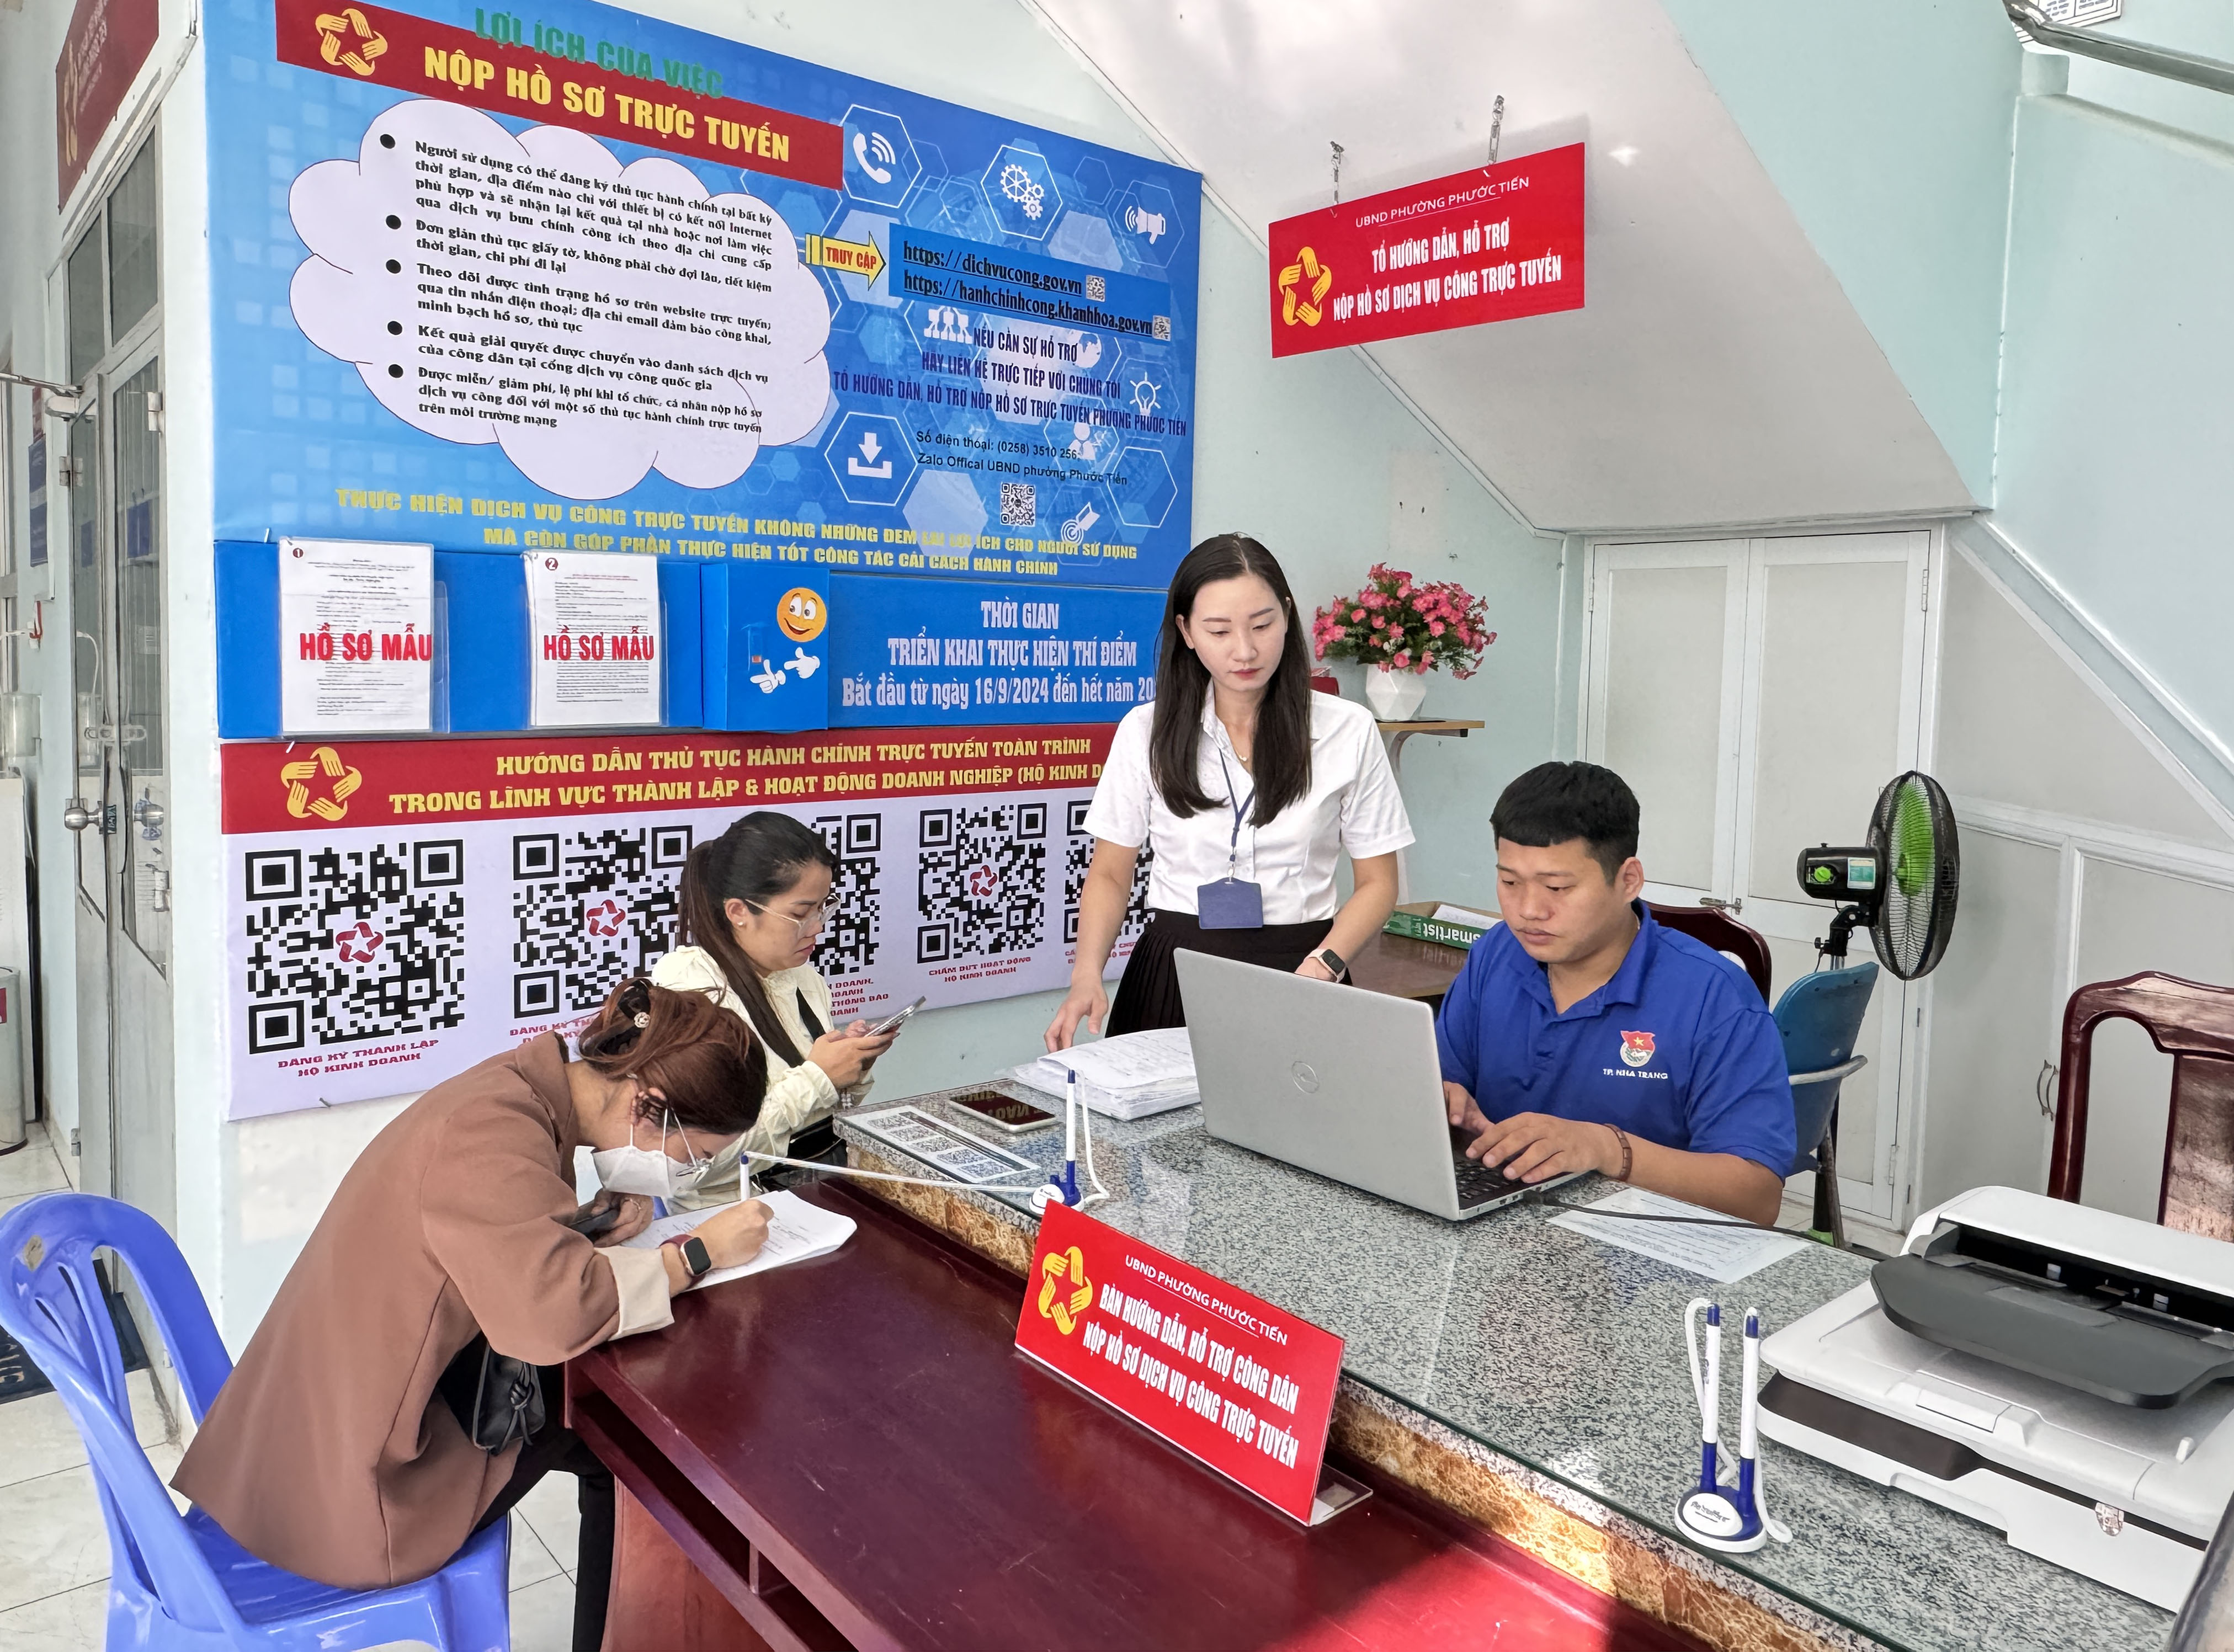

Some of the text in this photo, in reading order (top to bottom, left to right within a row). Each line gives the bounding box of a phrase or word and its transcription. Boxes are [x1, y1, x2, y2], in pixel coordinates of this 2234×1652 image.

[425, 46, 789, 162] NỘP HỒ SƠ TRỰC TUYẾN
[549, 188, 772, 239] nào Internet
[1356, 175, 1529, 227] UBND PHƯỜNG PHƯỚC TIẾN
[416, 197, 747, 267] qua dịch chính ích theo cung
[826, 247, 877, 272] TRUY CẬP
[903, 240, 1082, 295] https://dichvucong.gov.vn
[416, 263, 705, 318] Theo website
[417, 284, 657, 327] qua email
[552, 344, 723, 376] được vào danh sách
[577, 364, 711, 390] dịch vụ công gia
[916, 429, 1056, 457] Số điện (0258) 3510
[917, 452, 943, 466] Zalo
[987, 461, 1020, 473] UBND
[981, 596, 1059, 629] THỜI GIAN
[300, 622, 432, 661] HỒ SƠ MẪU
[544, 625, 655, 660] HỒ SƠ MẪU
[887, 626, 1136, 671] TRIỂN KHAI THỰC HIỆN THÍ ĐIỂM
[842, 672, 1134, 710] Bắt đầu từ ngày 16/9/2024 đến hết năm
[496, 737, 1091, 775] HƯỚNG DẪN THỦ TỤC HÀNH CHÍNH TRỰC TUYẾN TOÀN TRÌNH
[389, 791, 481, 813] TRONG
[490, 786, 550, 808] LĨNH
[557, 785, 605, 807] VỰC
[612, 780, 691, 802] THÀNH
[698, 777, 739, 800] LẬP
[746, 779, 758, 795] &
[764, 776, 818, 796] HOẠT
[823, 771, 876, 793] ĐỘNG
[881, 770, 944, 788] DOANH
[949, 765, 1013, 786] NGHIỆP
[1018, 763, 1044, 784] (HỘ
[1049, 764, 1087, 780] KINH
[1638, 1070, 1668, 1079] TRANG
[1125, 1255, 1287, 1345] UBND PHƯỜNG PHƯỚC TIẾN
[1099, 1283, 1299, 1414] BÀN TRỢ CÔNG DÂN
[1083, 1321, 1299, 1469] NỘP HỒ SƠ DỊCH VỤ CÔNG TRỰC TUYẾN
